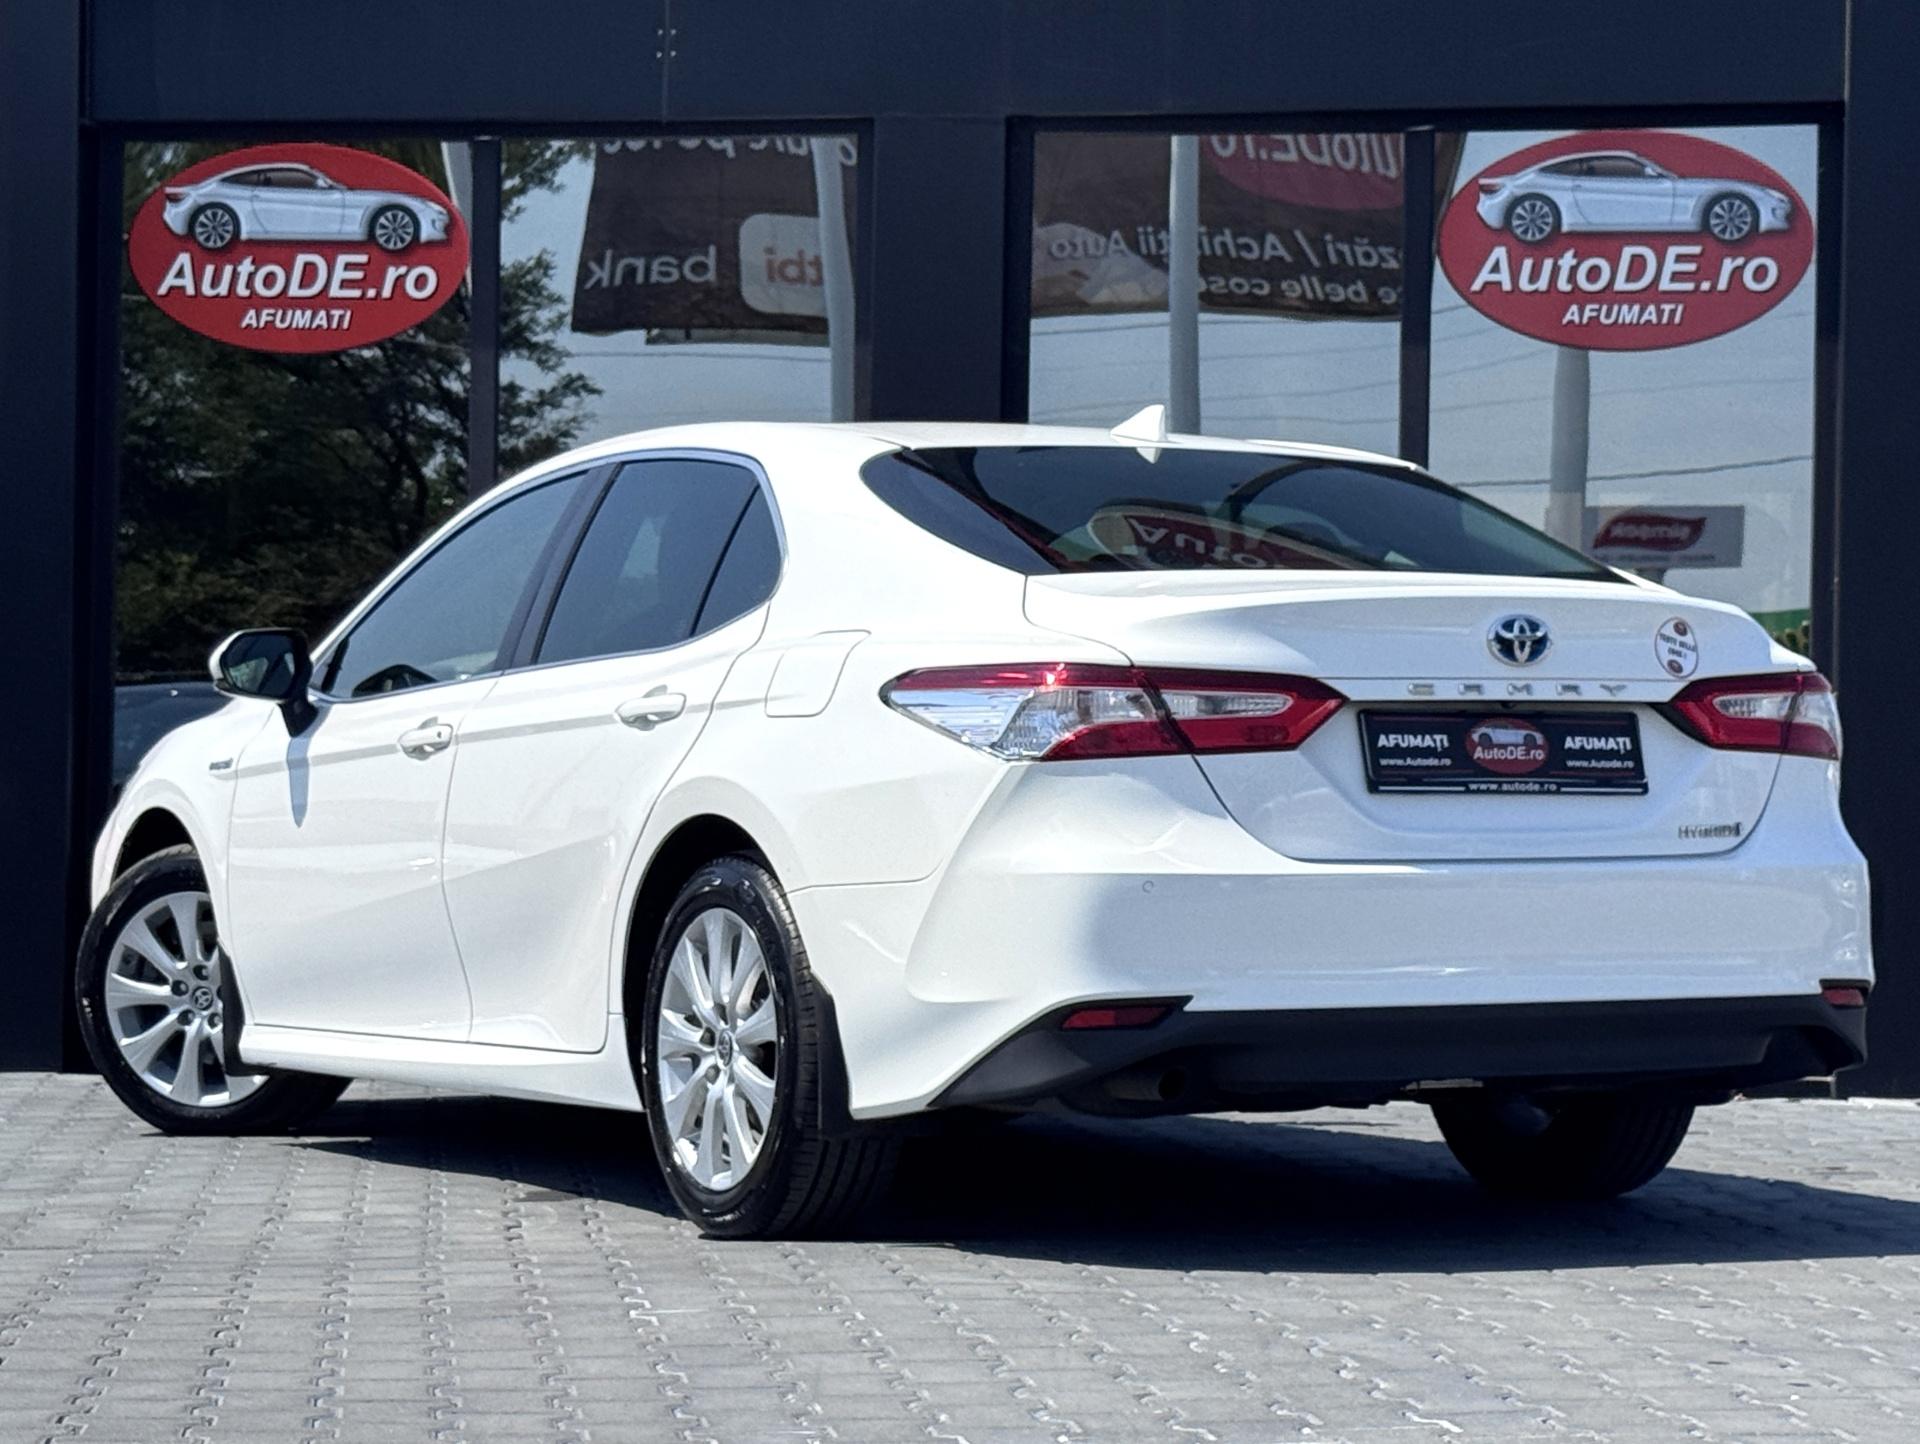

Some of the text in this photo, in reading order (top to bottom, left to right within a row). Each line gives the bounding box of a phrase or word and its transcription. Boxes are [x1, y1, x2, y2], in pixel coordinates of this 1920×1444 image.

[157, 252, 439, 300] AutoDE.ro
[1470, 245, 1779, 293] AutoDE.ro
[240, 309, 352, 330] AFUMATI
[1561, 303, 1684, 325] AFUMATI
[1473, 745, 1545, 760] AutoDE.ro
